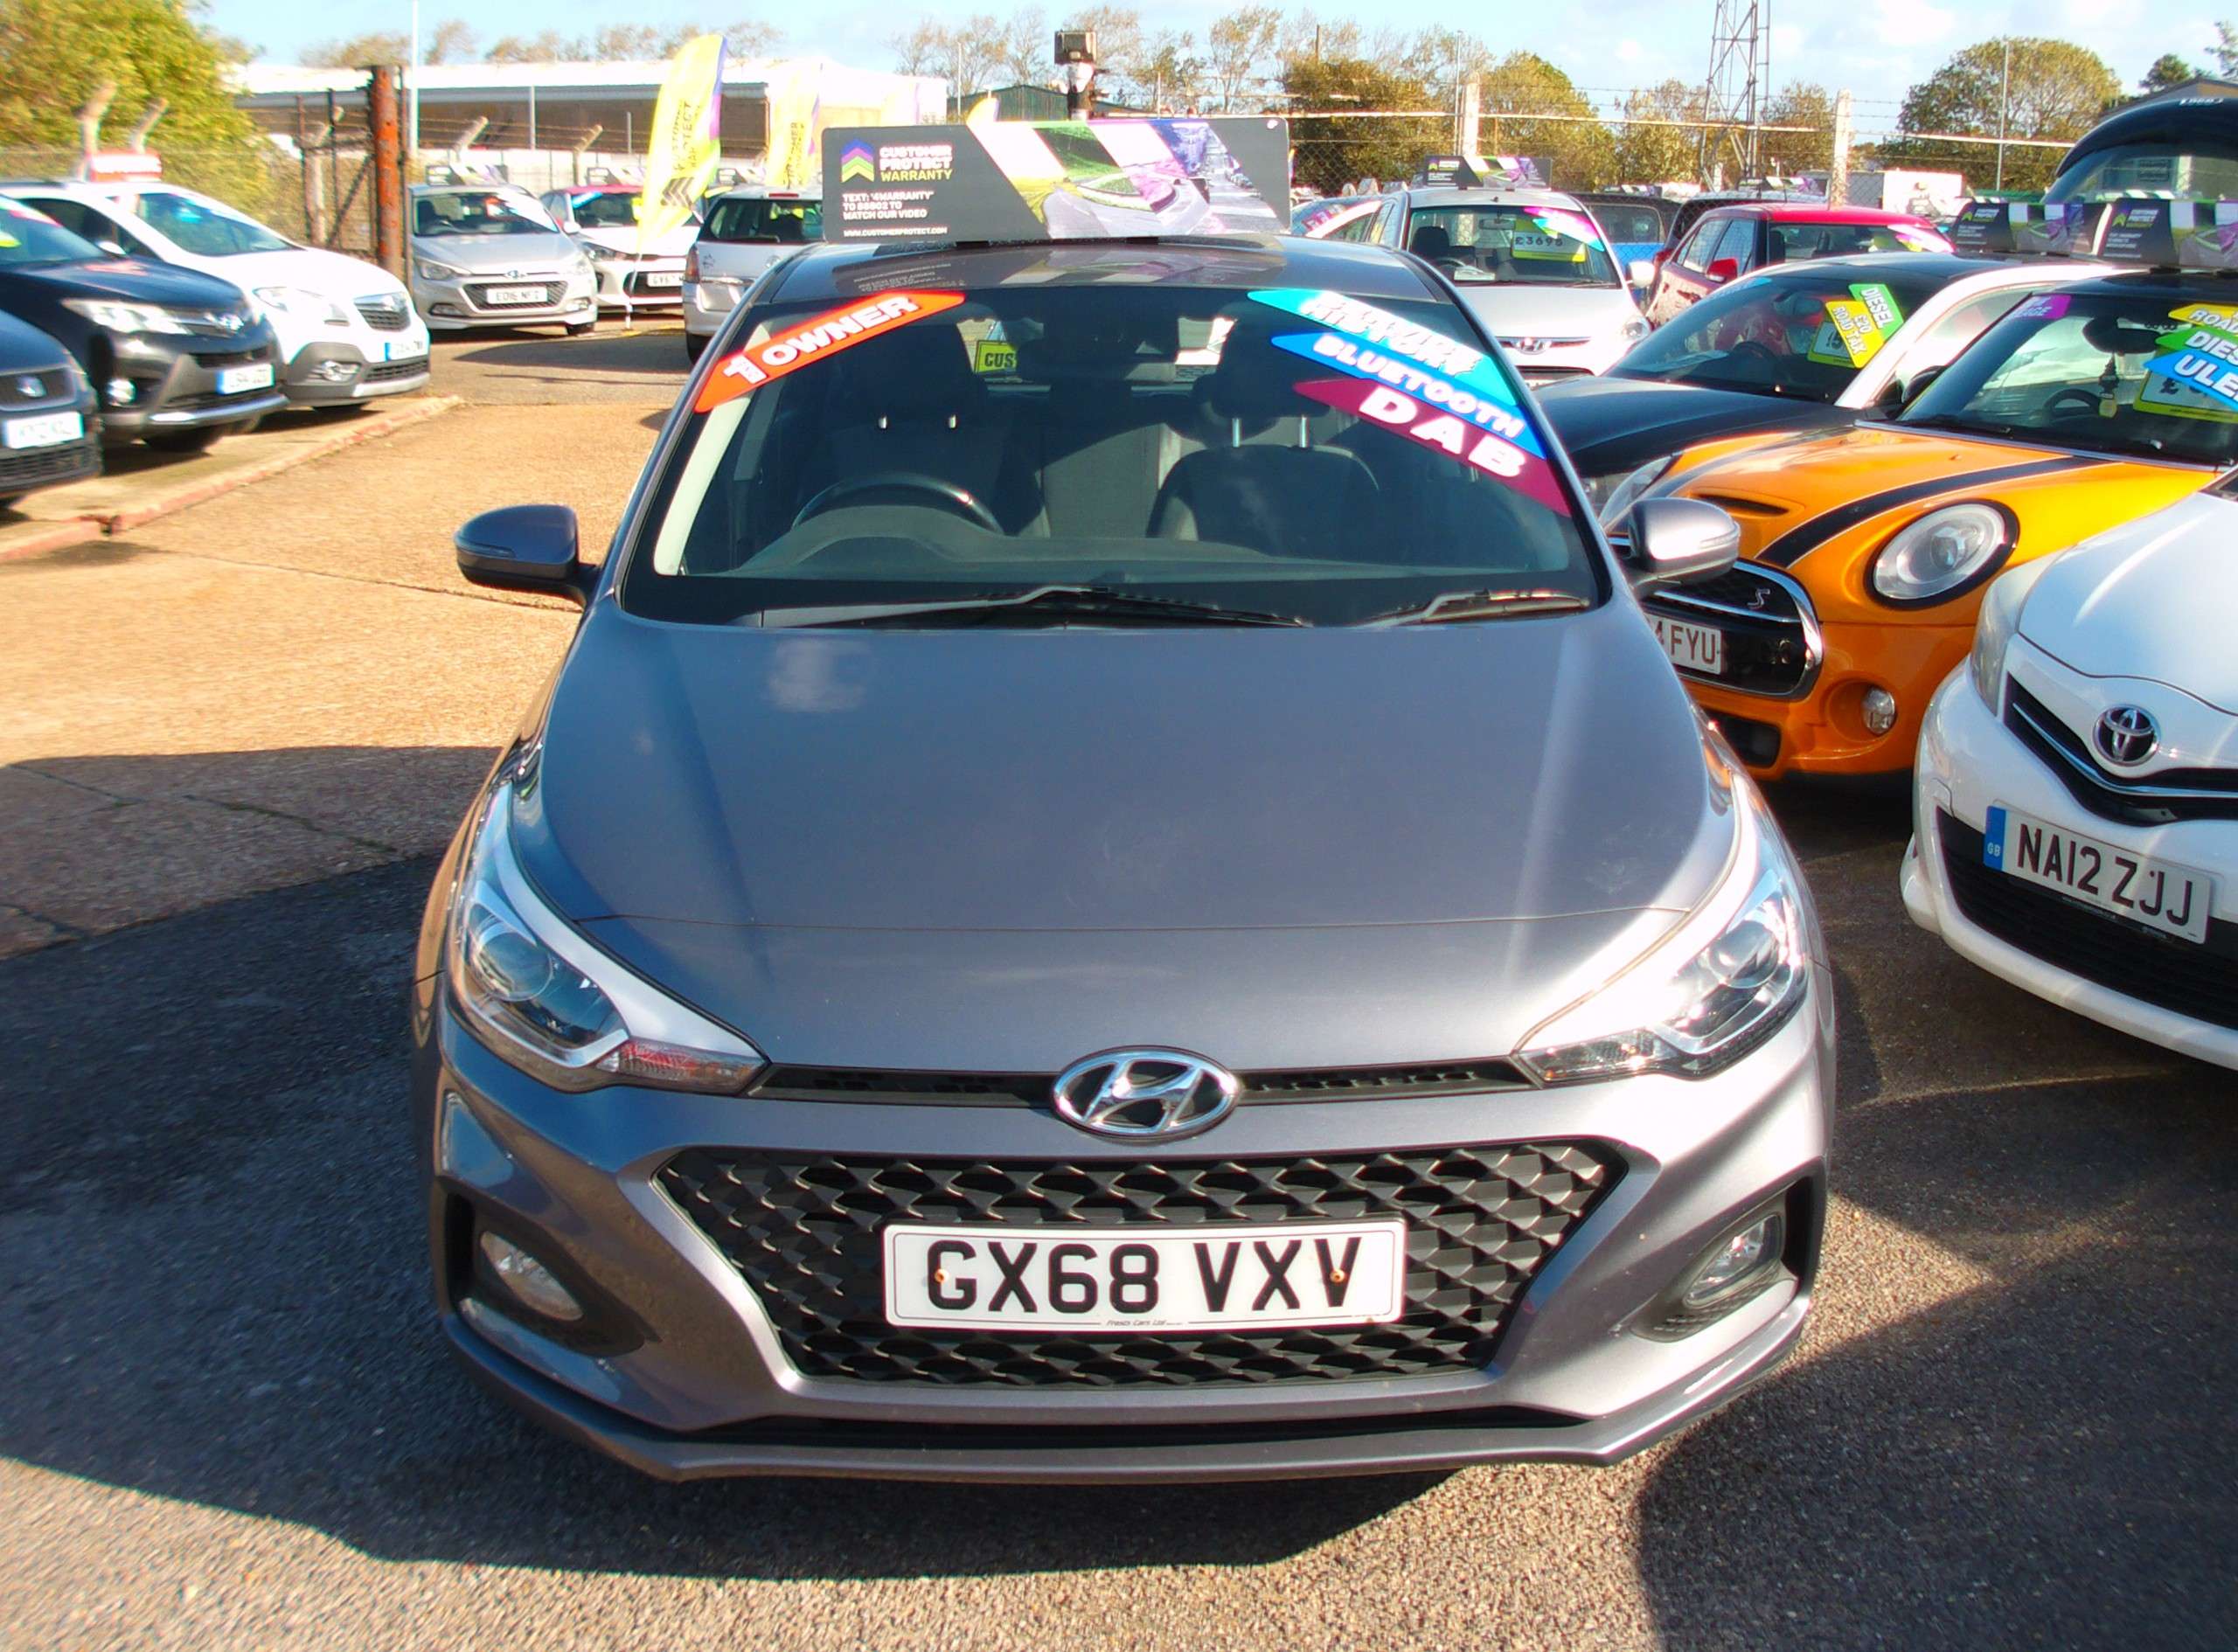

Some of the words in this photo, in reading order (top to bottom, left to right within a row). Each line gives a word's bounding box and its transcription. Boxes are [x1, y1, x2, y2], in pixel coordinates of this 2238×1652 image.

[879, 145, 952, 157] CUSTOMER
[879, 157, 953, 170] PROTECT
[880, 170, 953, 182] WARRANTY
[843, 202, 856, 211] TO
[890, 201, 902, 210] TO
[843, 211, 876, 220] WATCH
[899, 209, 928, 218] VIDEO
[1860, 288, 1894, 330] DIESEL
[723, 355, 770, 385] 1
[761, 294, 921, 366] OWNER
[1832, 306, 1854, 331] ROAD
[1845, 331, 1867, 355] TAX
[1313, 335, 1526, 440] BLUETOOTH
[2174, 354, 2238, 403] ULE
[1358, 385, 1530, 479] DAB
[1671, 626, 1715, 665] FYU
[1987, 842, 2001, 856] GB
[2017, 823, 2102, 896] NA12
[2111, 856, 2193, 927] ZJJ
[927, 1239, 1159, 1314] GX68
[1192, 1236, 1362, 1313] VXV
